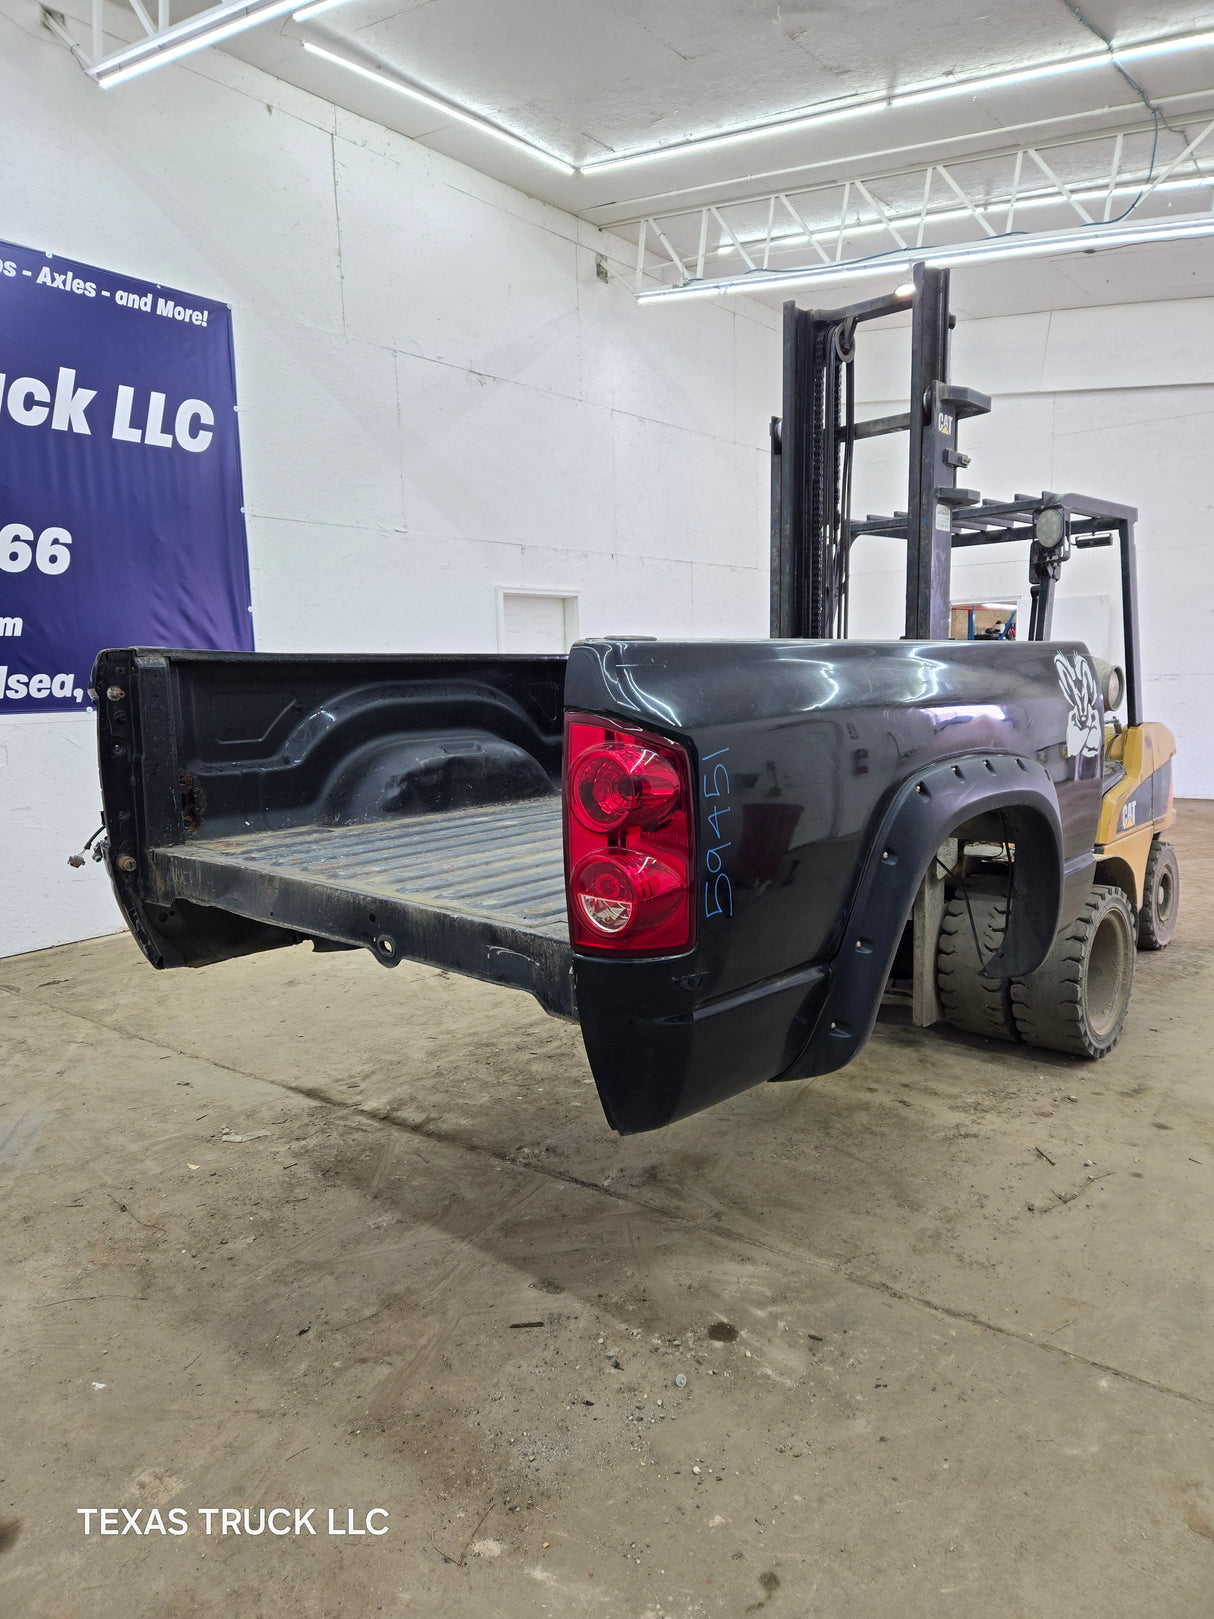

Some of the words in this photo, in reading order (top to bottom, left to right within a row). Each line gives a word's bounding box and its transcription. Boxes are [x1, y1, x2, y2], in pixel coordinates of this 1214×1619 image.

[0, 259, 17, 277] s
[36, 266, 97, 298] Axles
[115, 290, 152, 312] and
[156, 298, 209, 327] More!
[0, 367, 98, 435] ck
[112, 385, 215, 453] LLC
[938, 412, 954, 435] CAT
[0, 523, 73, 576] 66
[702, 747, 733, 918] 59451
[1122, 800, 1137, 830] CAT
